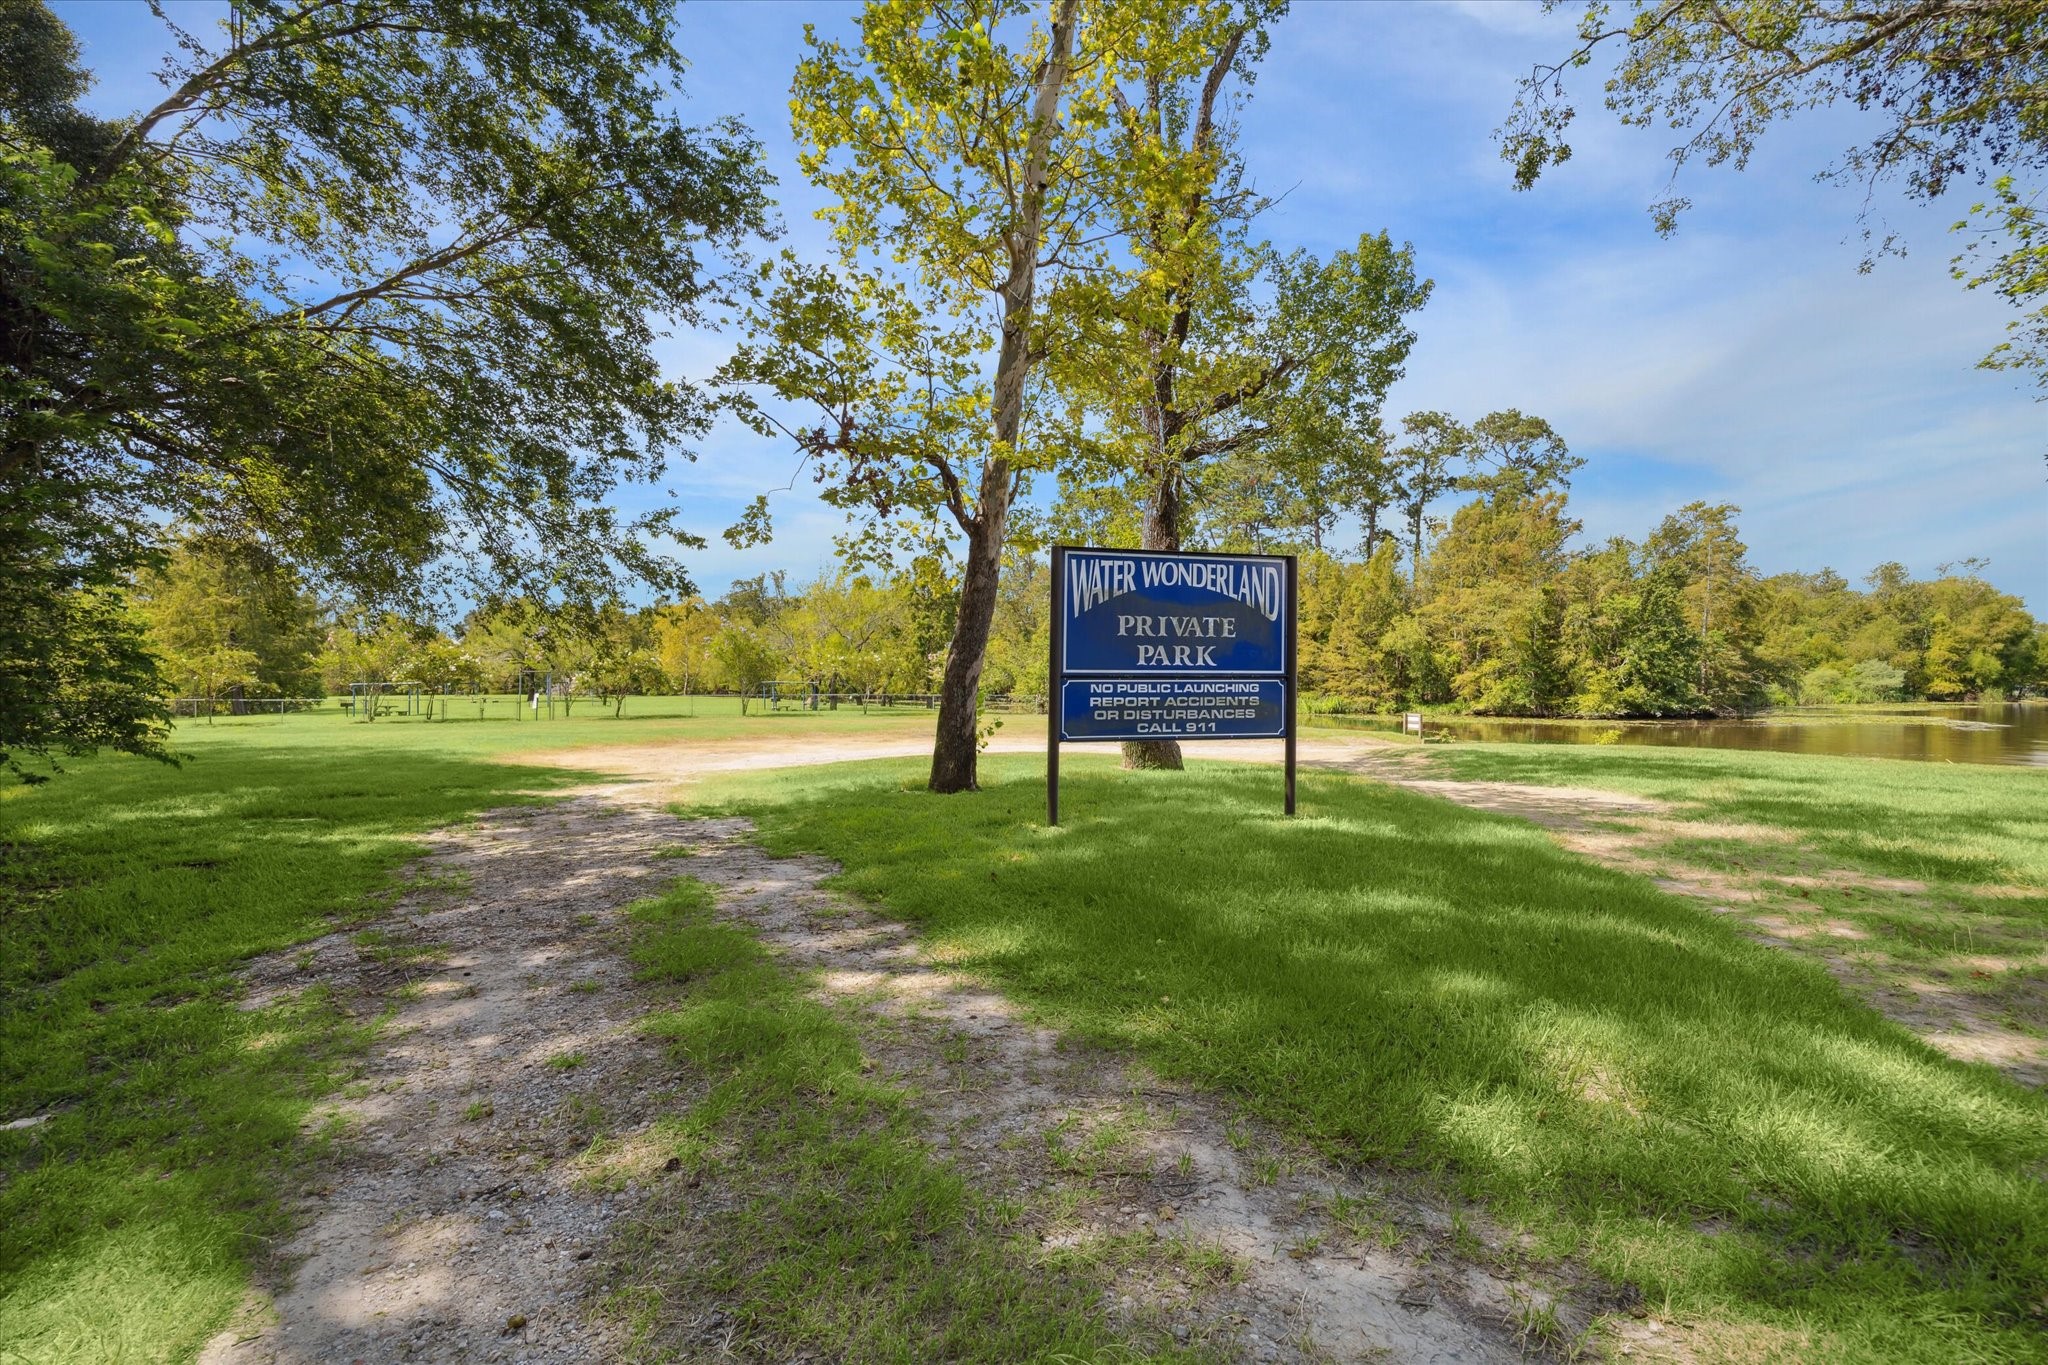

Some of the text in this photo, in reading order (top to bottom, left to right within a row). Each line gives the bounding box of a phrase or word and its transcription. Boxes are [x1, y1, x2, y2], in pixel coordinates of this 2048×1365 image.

[1071, 559, 1279, 622] WATER WONDERLAND
[1117, 615, 1236, 638] PRIVATE
[1137, 645, 1217, 666] PARK
[1091, 684, 1259, 693] NO PUBLIC LAUNCHING
[1090, 697, 1260, 706] REPORT ACCIDENTS
[1094, 709, 1255, 720] OR DISTURBANCES
[1137, 723, 1216, 733] CALL 911
